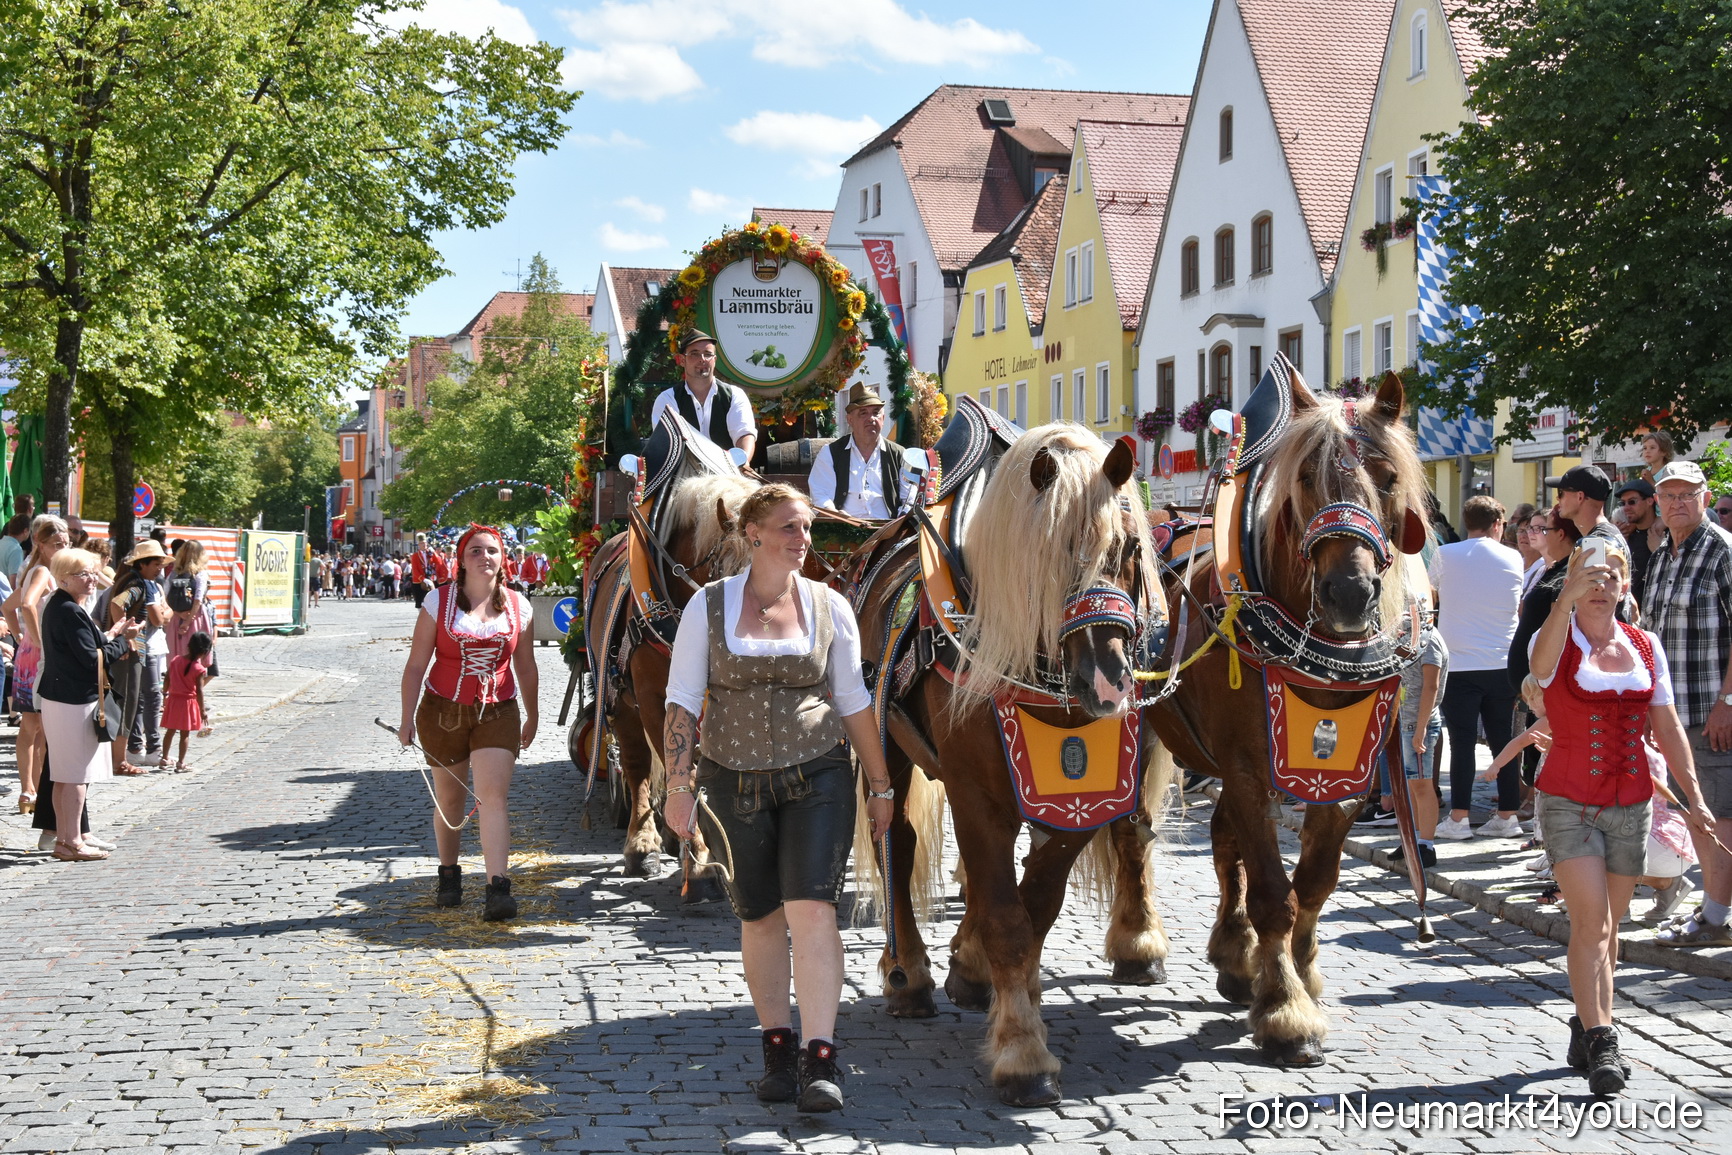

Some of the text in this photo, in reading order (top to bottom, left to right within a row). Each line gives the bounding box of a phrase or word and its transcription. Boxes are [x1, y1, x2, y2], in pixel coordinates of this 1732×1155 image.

[871, 241, 895, 279] K&L
[732, 287, 802, 298] Neumarkter
[719, 299, 814, 314] Lammsbräu
[985, 357, 1007, 381] HOTEL
[1542, 414, 1556, 428] KINO
